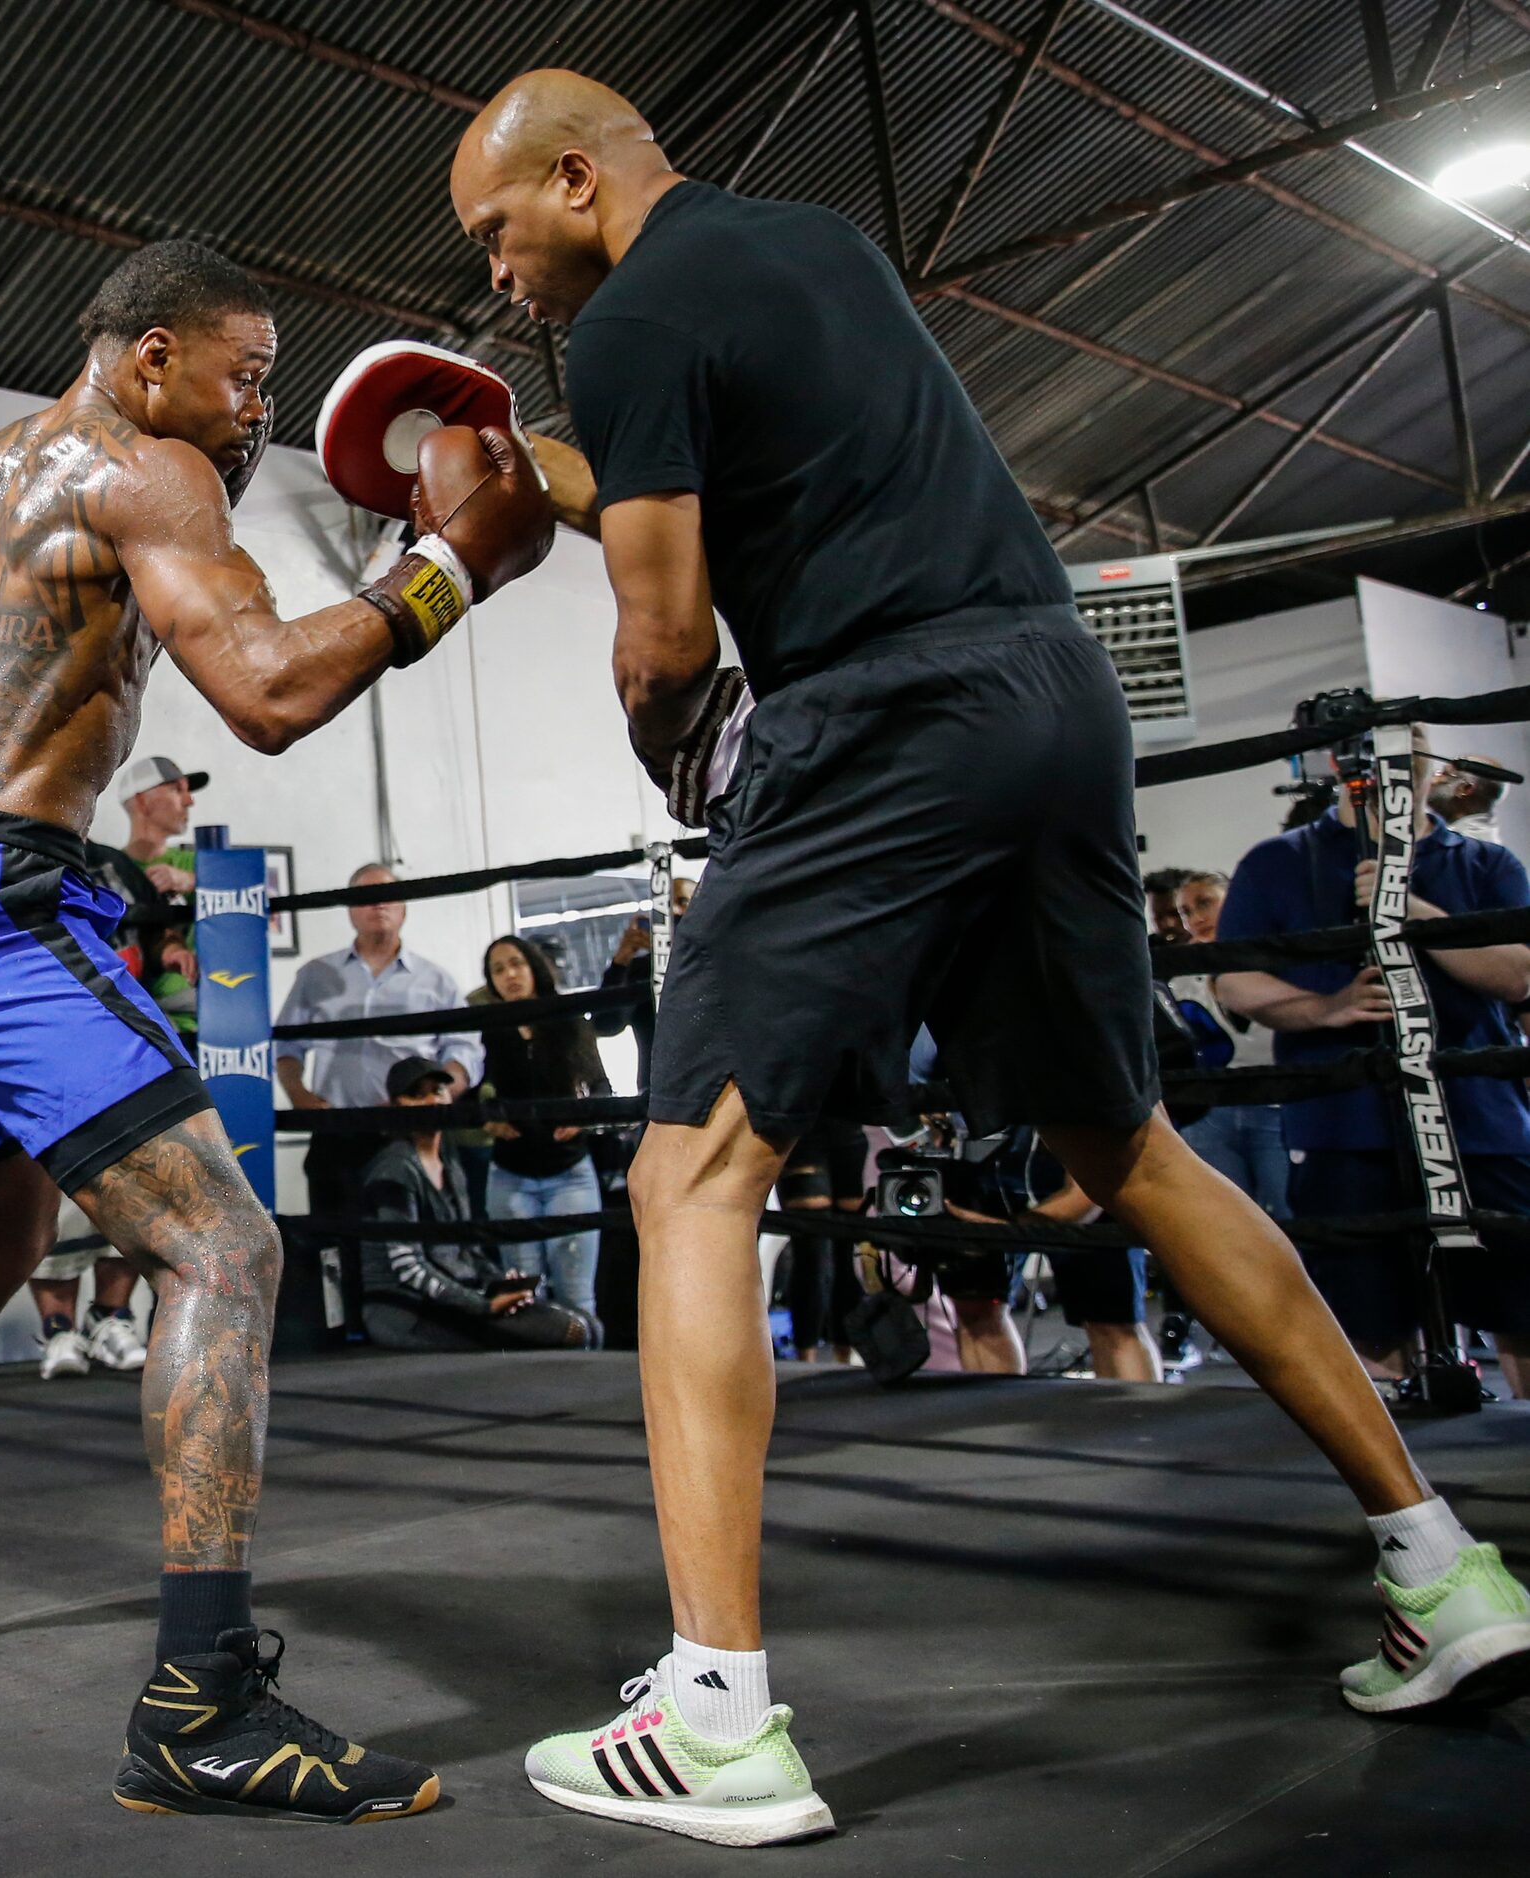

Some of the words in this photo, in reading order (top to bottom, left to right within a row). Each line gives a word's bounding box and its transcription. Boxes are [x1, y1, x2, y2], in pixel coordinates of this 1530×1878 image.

[196, 884, 268, 922] EVERLAST
[1373, 759, 1414, 966] EVERLAST
[198, 1040, 271, 1082] EVERLAST
[1398, 1011, 1463, 1218] EVERLAST
